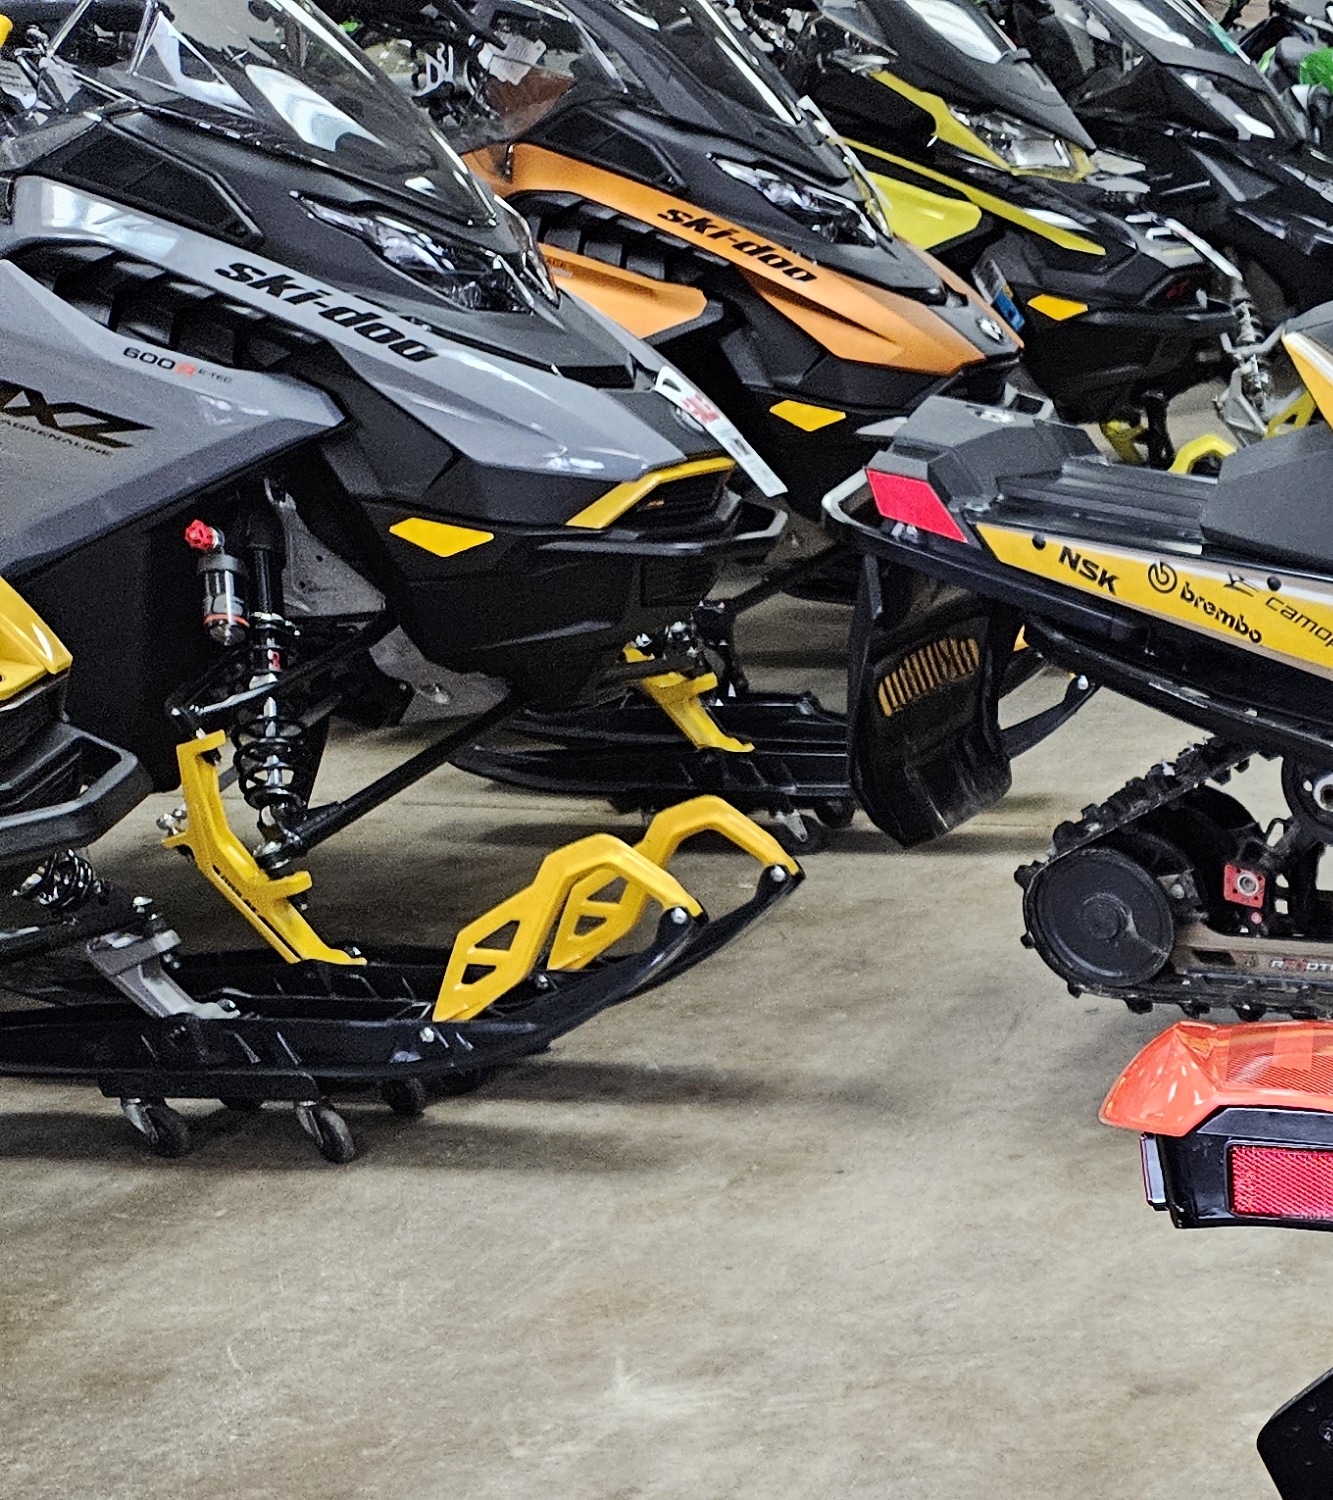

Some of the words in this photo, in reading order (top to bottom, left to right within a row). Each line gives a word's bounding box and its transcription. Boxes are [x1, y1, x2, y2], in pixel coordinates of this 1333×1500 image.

[657, 209, 818, 283] ski-doo
[214, 262, 438, 362] ski-doo
[1058, 545, 1120, 596] NSK
[1180, 581, 1263, 644] brembo
